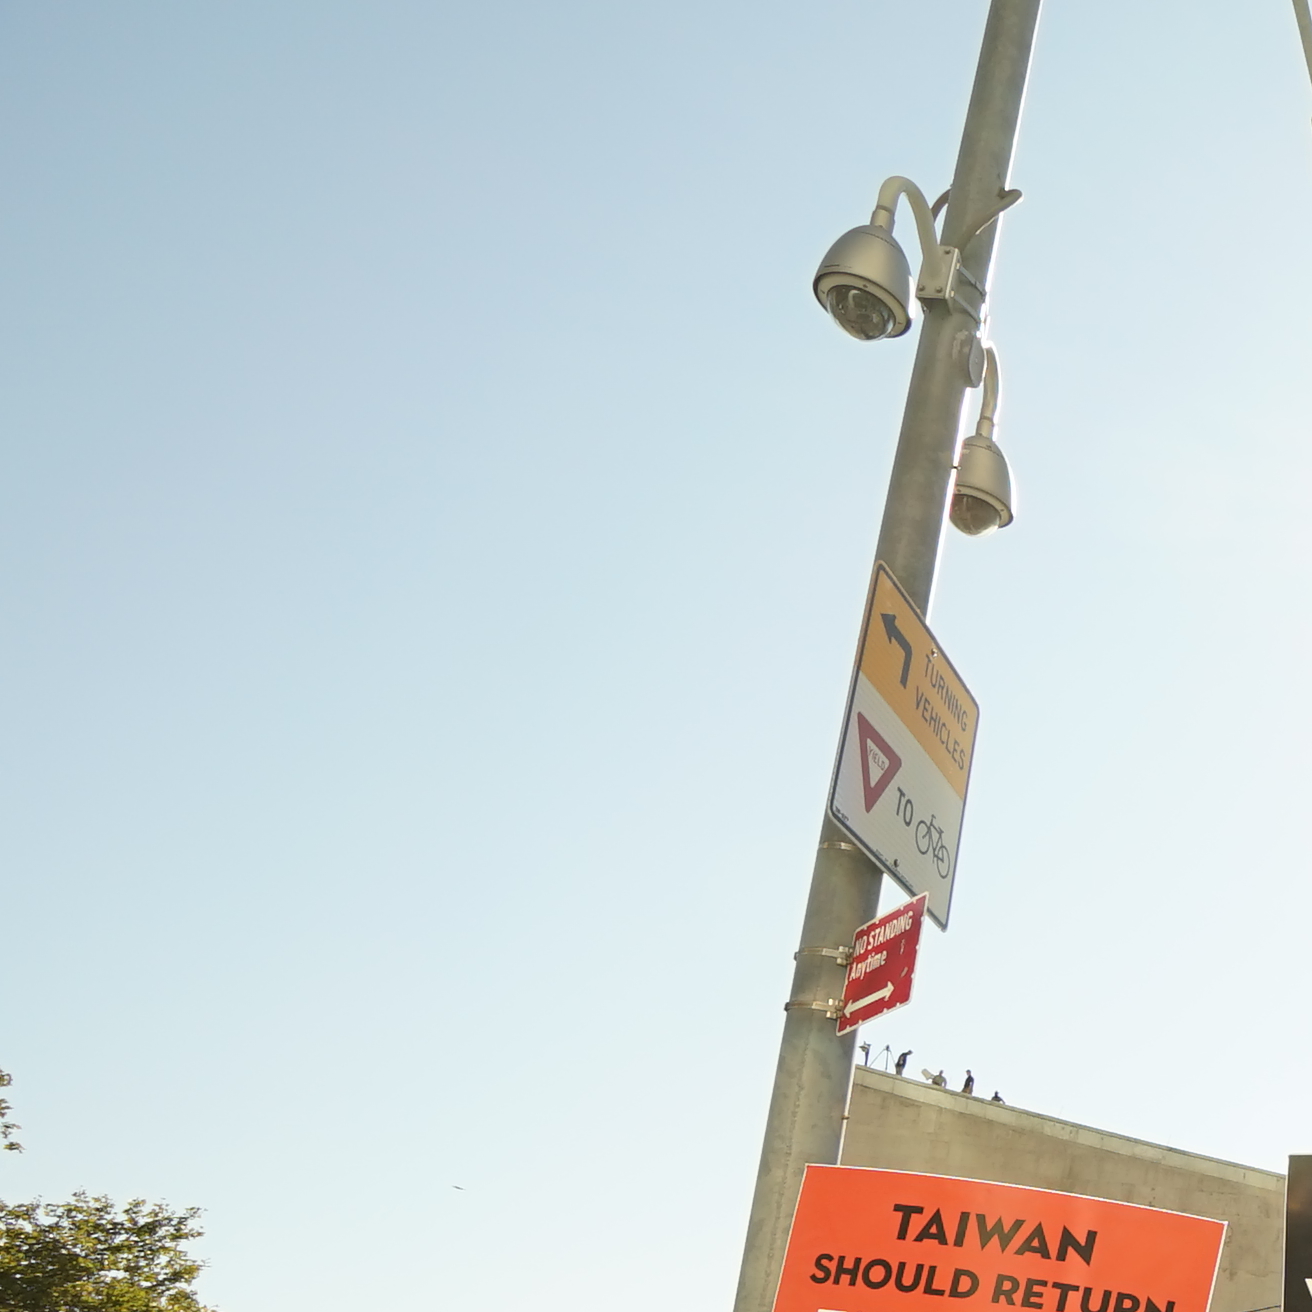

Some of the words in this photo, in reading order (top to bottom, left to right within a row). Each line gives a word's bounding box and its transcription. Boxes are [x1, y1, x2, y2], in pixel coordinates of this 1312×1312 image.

[925, 654, 968, 732] TURNING
[915, 685, 966, 771] VEHICLES
[868, 745, 886, 771] YIELD
[897, 786, 914, 827] TO
[854, 936, 868, 956] NO
[867, 911, 914, 950] STANDING
[849, 950, 888, 981] Anytime
[893, 1204, 1097, 1265] TAIWAN
[810, 1254, 980, 1298] SHOULD
